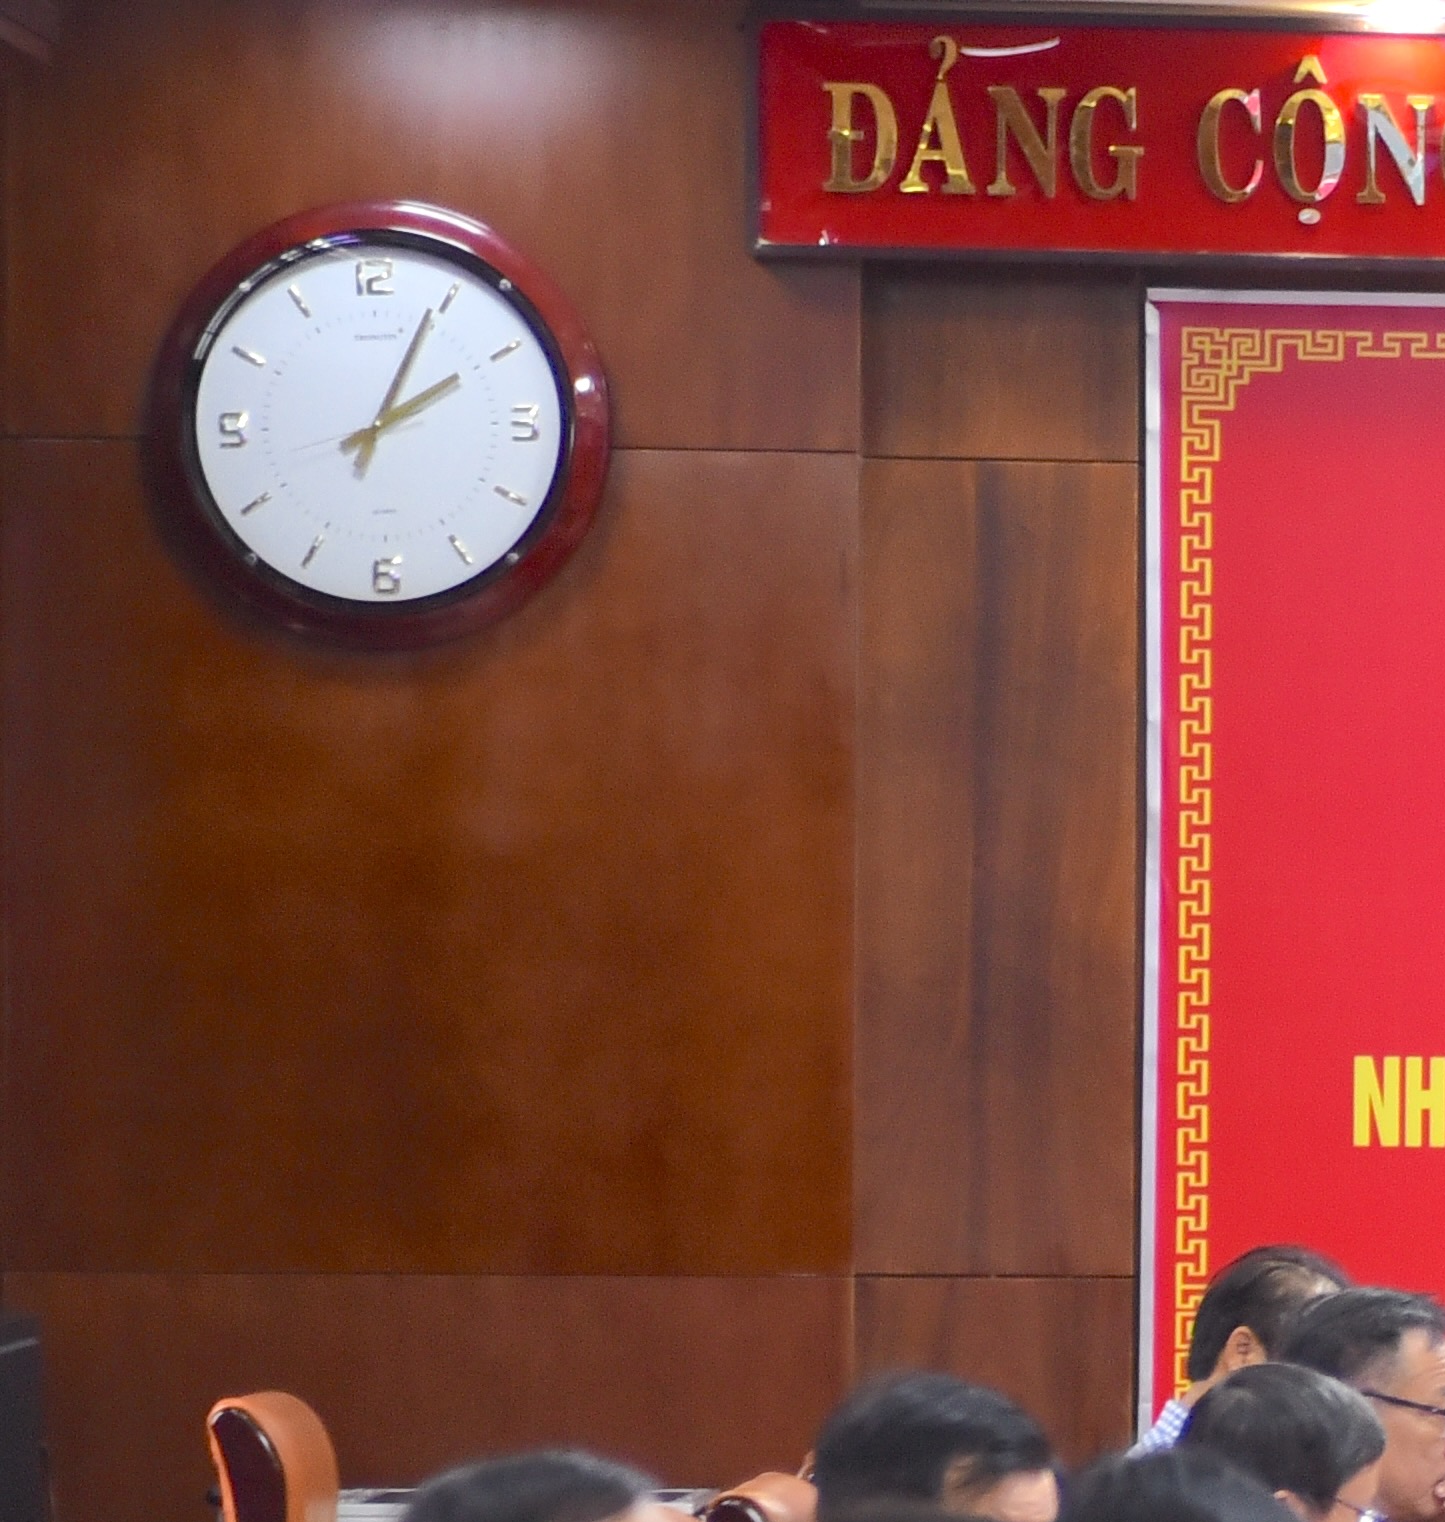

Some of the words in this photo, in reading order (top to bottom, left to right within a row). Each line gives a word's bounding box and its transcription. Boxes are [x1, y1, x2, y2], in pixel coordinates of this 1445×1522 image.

[822, 35, 1144, 201] ĐẢNG
[356, 258, 394, 296] 12
[511, 403, 540, 442] 3
[372, 555, 402, 594] 6
